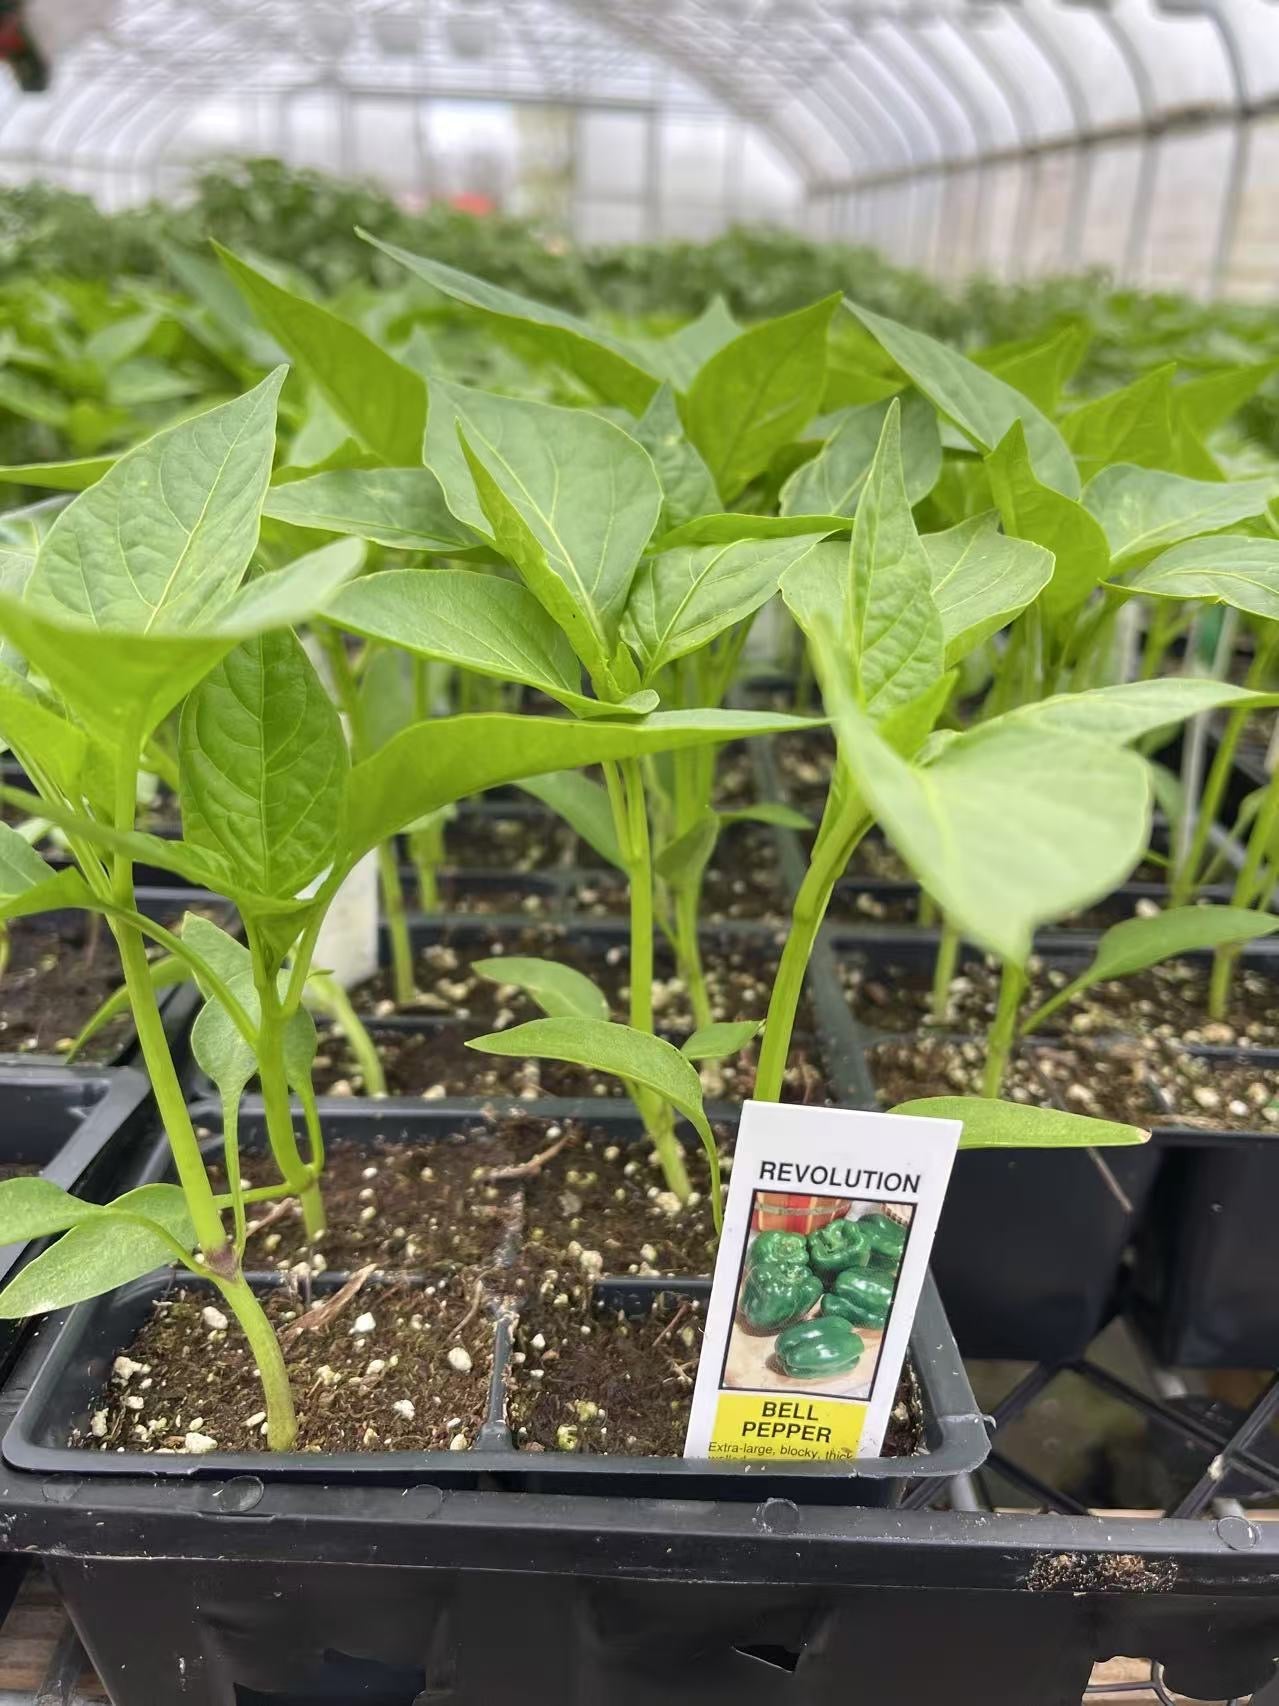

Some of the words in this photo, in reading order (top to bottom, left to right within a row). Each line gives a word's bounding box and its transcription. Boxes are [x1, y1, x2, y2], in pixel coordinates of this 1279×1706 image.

[759, 1160, 921, 1193] REVOLUTION
[762, 1401, 819, 1421] BELL
[741, 1421, 832, 1443] PEPPER
[708, 1441, 776, 1456] Extra-large,
[780, 1445, 820, 1459] blocky,
